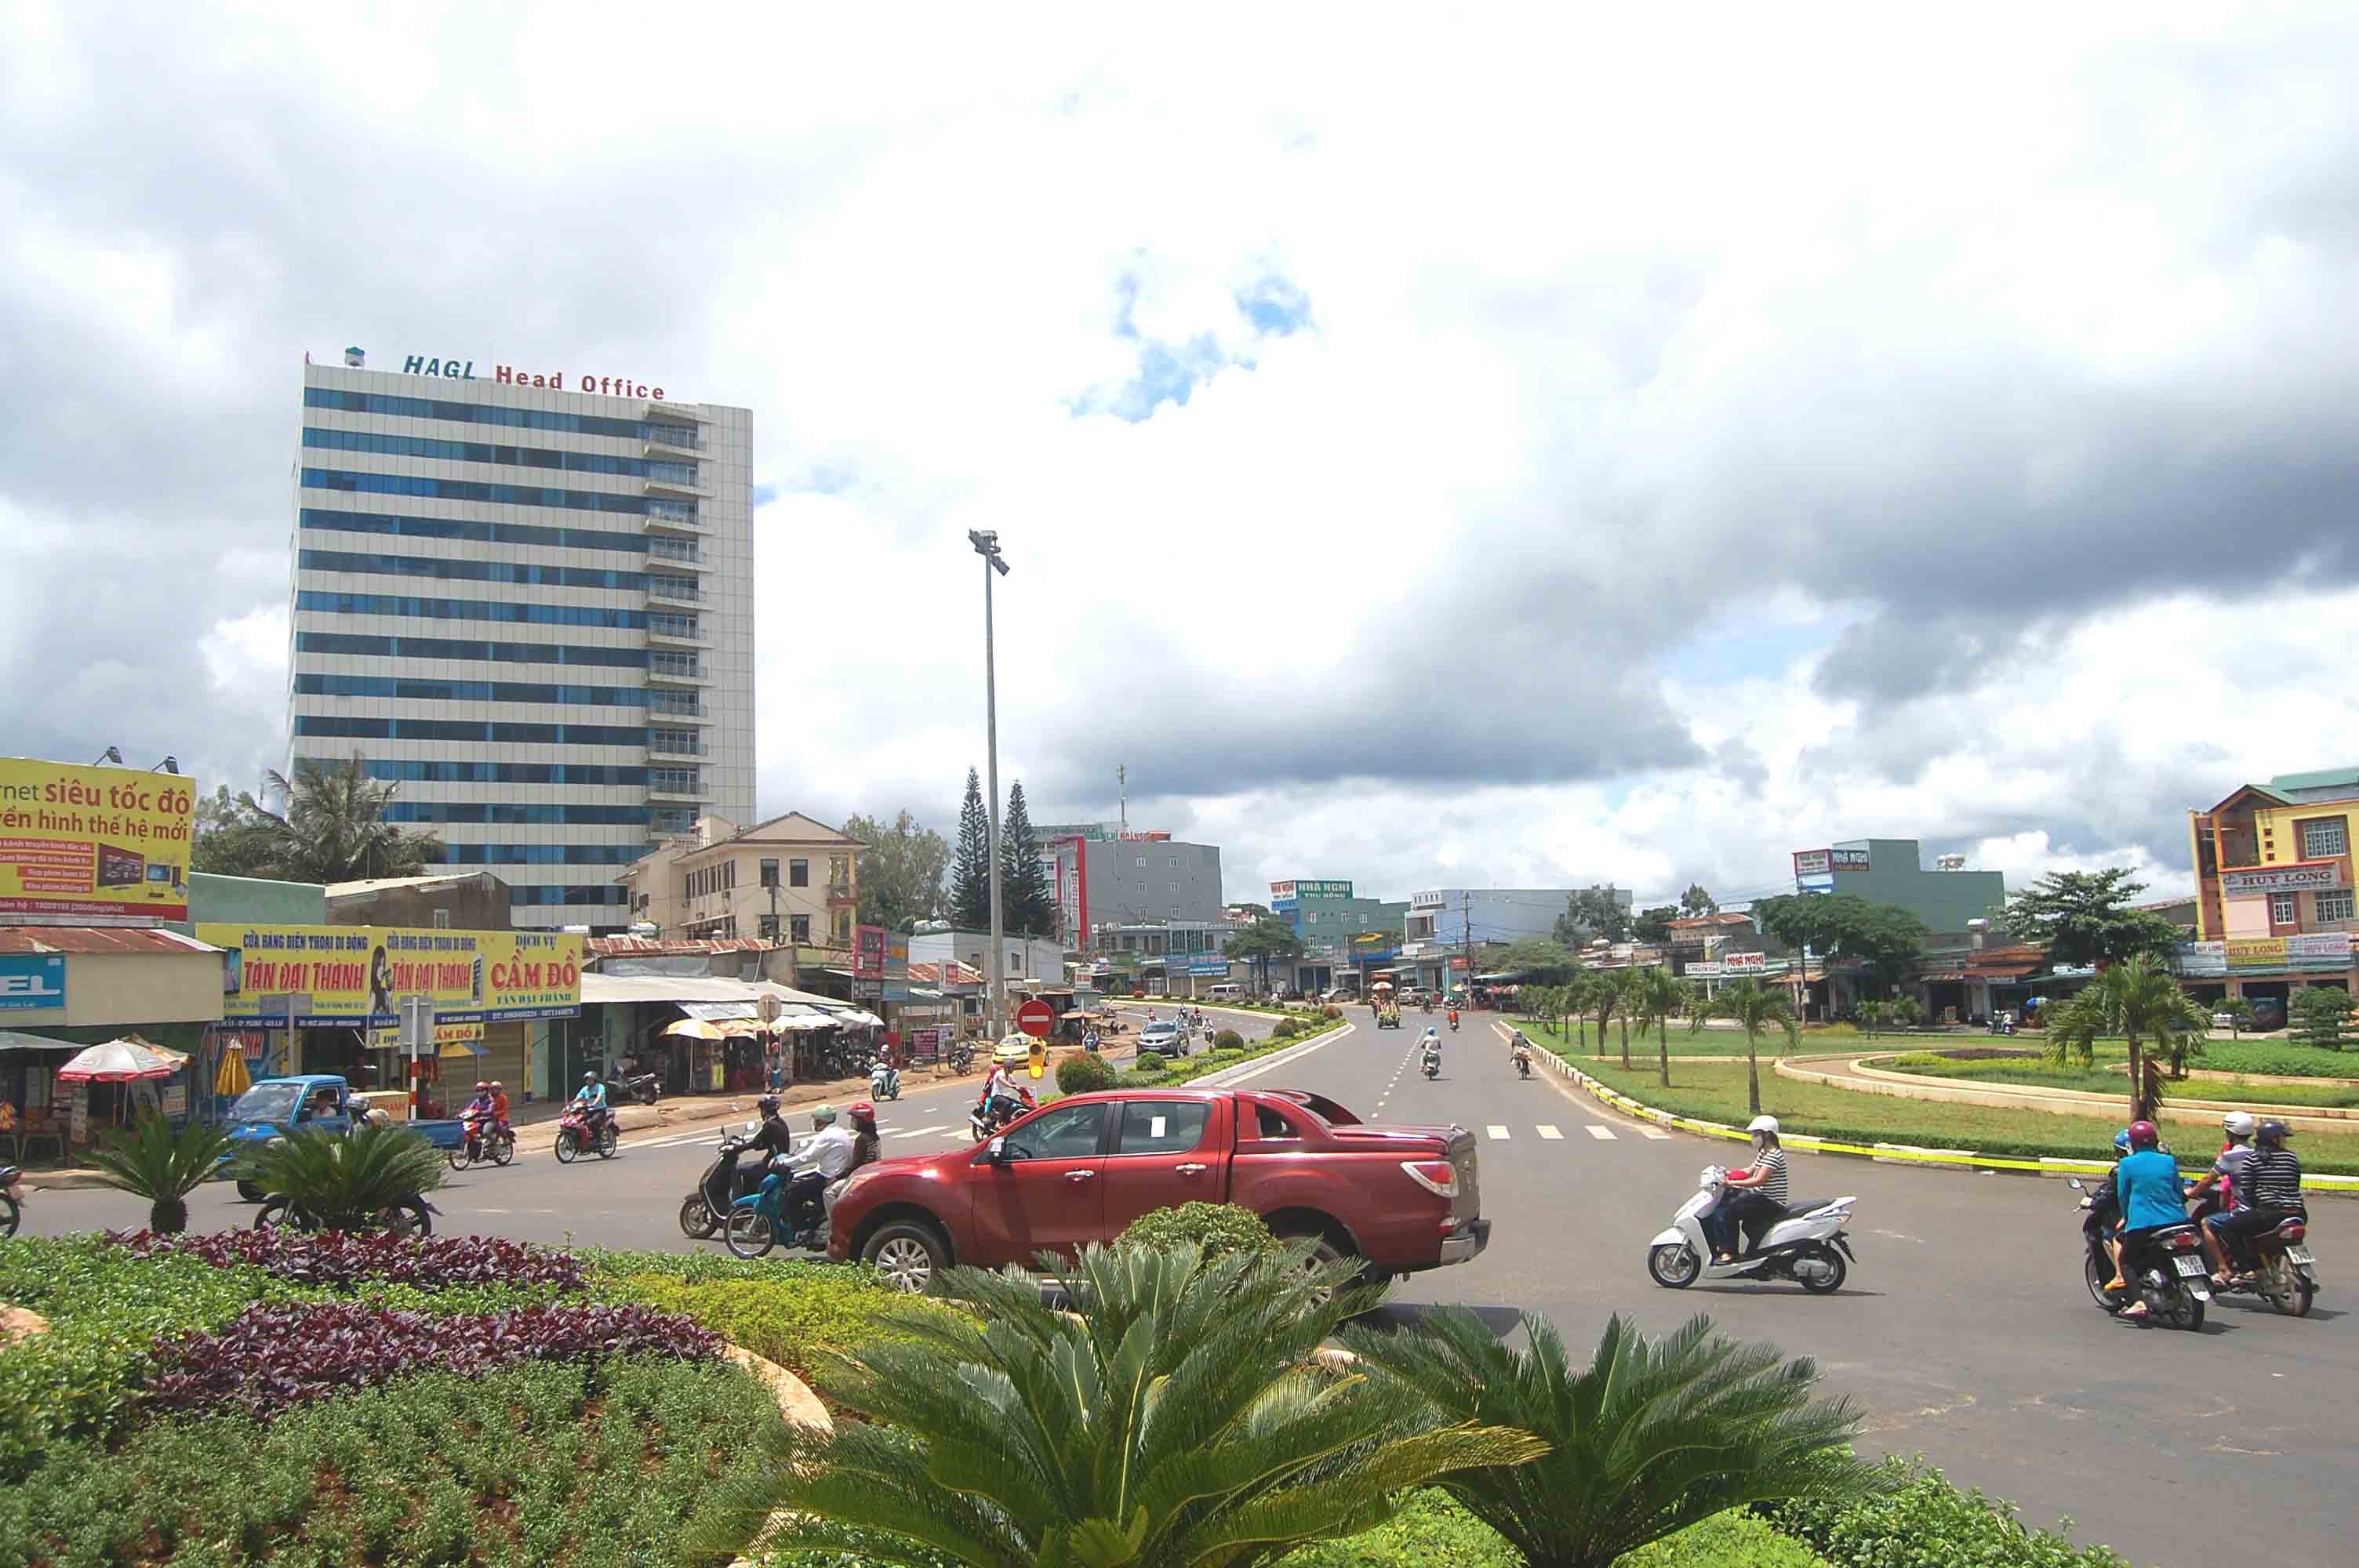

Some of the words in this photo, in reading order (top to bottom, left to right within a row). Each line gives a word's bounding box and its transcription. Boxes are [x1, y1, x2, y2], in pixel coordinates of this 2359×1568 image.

[403, 354, 476, 381] HAGL
[496, 365, 562, 390] Head
[581, 375, 665, 400] Office
[45, 777, 101, 807] siêu
[110, 781, 151, 811] tốc
[157, 787, 191, 821] độ
[38, 808, 83, 833] hình
[88, 814, 120, 836] thế
[125, 817, 148, 844] hệ
[152, 821, 187, 841] mới
[2242, 876, 2279, 885] HUY
[2284, 871, 2332, 883] LONG
[335, 935, 344, 950] DI
[515, 935, 540, 951] DỊCH
[543, 935, 558, 951] VỤ
[2228, 947, 2249, 956] HUY
[2253, 946, 2283, 955] LONG
[243, 956, 277, 992] TÂN
[313, 956, 365, 992] THÀNH
[490, 947, 542, 991] CẦM
[547, 948, 578, 989] ĐỒ
